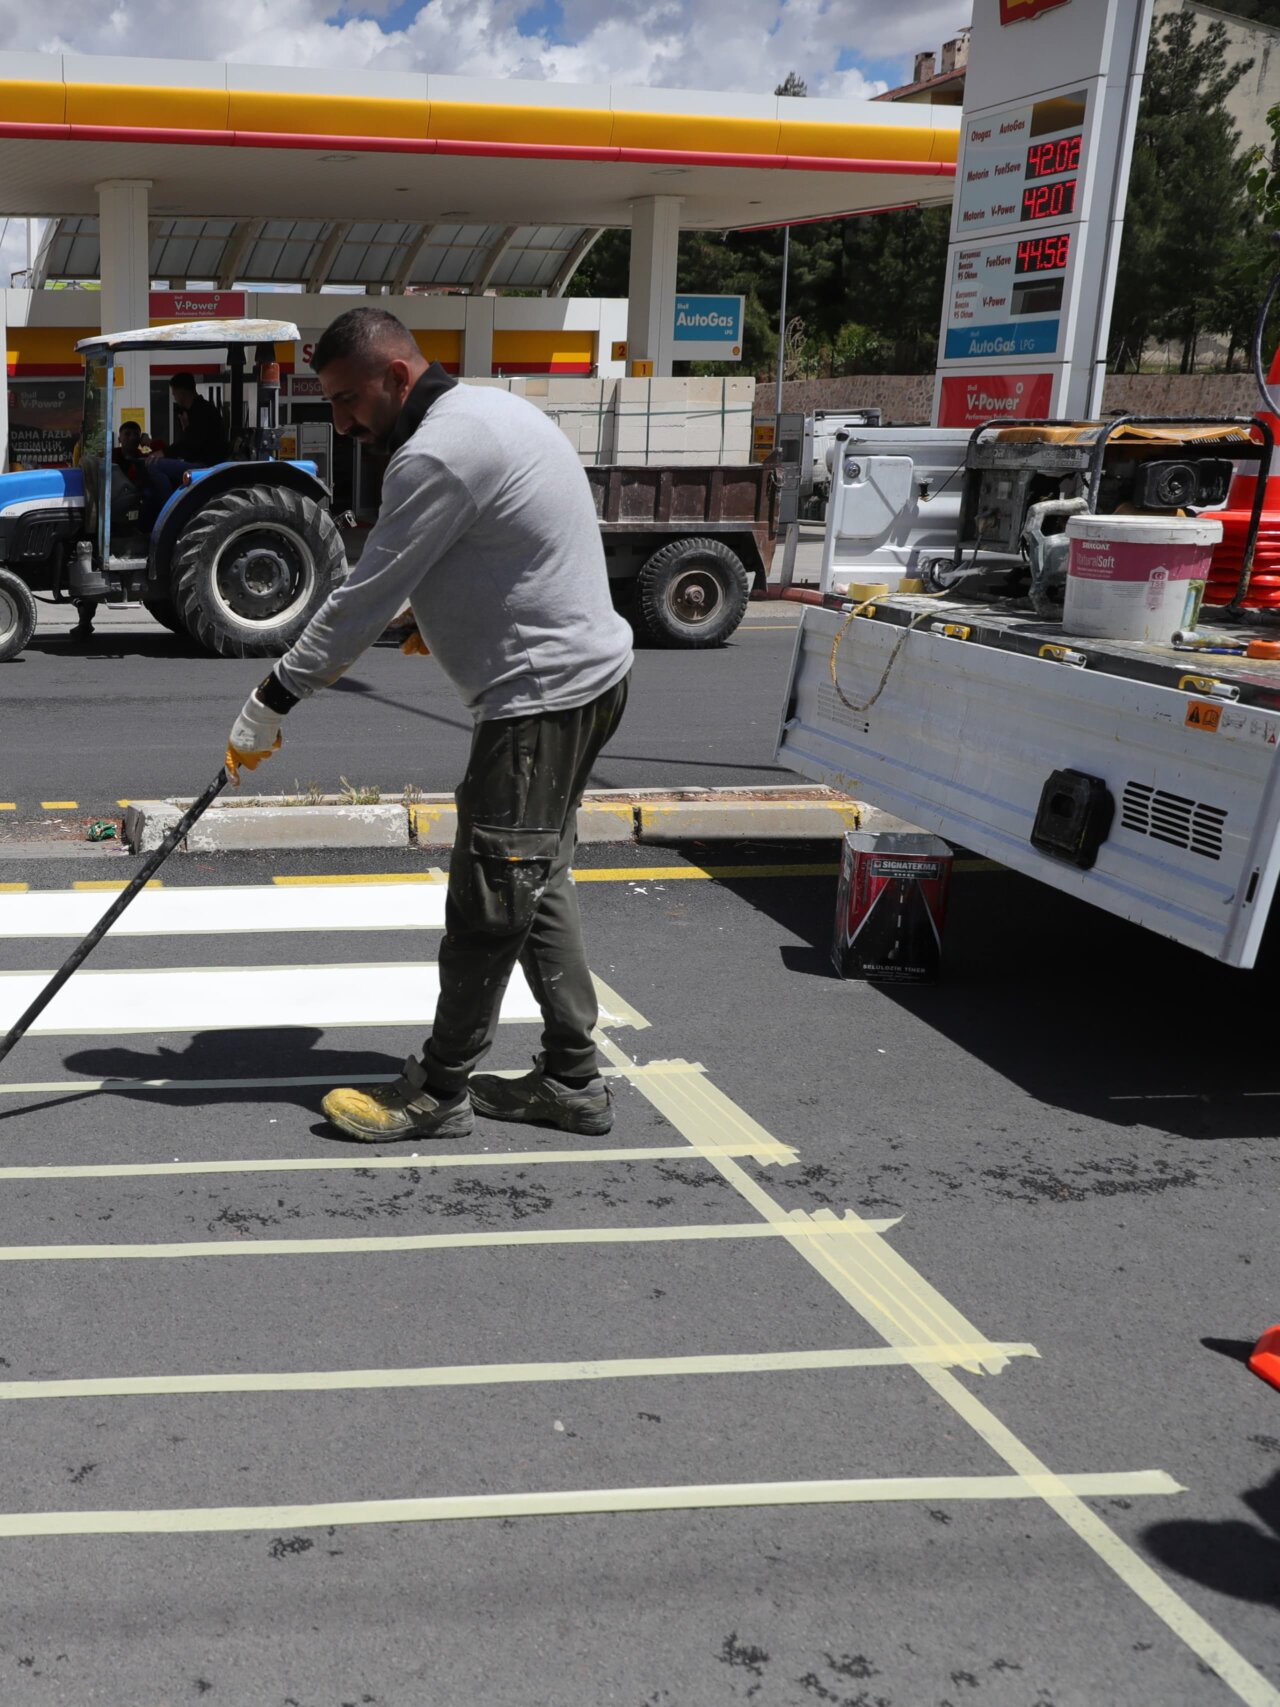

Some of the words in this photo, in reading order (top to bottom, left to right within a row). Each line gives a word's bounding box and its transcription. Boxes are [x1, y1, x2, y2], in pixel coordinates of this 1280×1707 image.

[971, 129, 992, 142] Otogaz
[999, 120, 1025, 134] AutoGas
[1029, 136, 1082, 176] 42.02
[967, 169, 989, 182] Motorin
[994, 162, 1021, 176] FuelSave
[1023, 181, 1077, 219] 42.07
[963, 209, 985, 222] Motorin
[991, 204, 1016, 217] V-Power
[985, 256, 1012, 268] FuelSave
[1017, 236, 1070, 272] 44.58
[174, 301, 218, 311] V-Power
[982, 296, 1006, 308] V-Power
[676, 311, 734, 327] AutoGas
[618, 344, 625, 357] 2
[968, 337, 1016, 355] AutoGas
[1019, 339, 1035, 352] LPG
[21, 400, 64, 409] V-Power
[966, 394, 1020, 411] V-Power
[10, 430, 40, 440] DAHA
[42, 429, 72, 439] FAZLA
